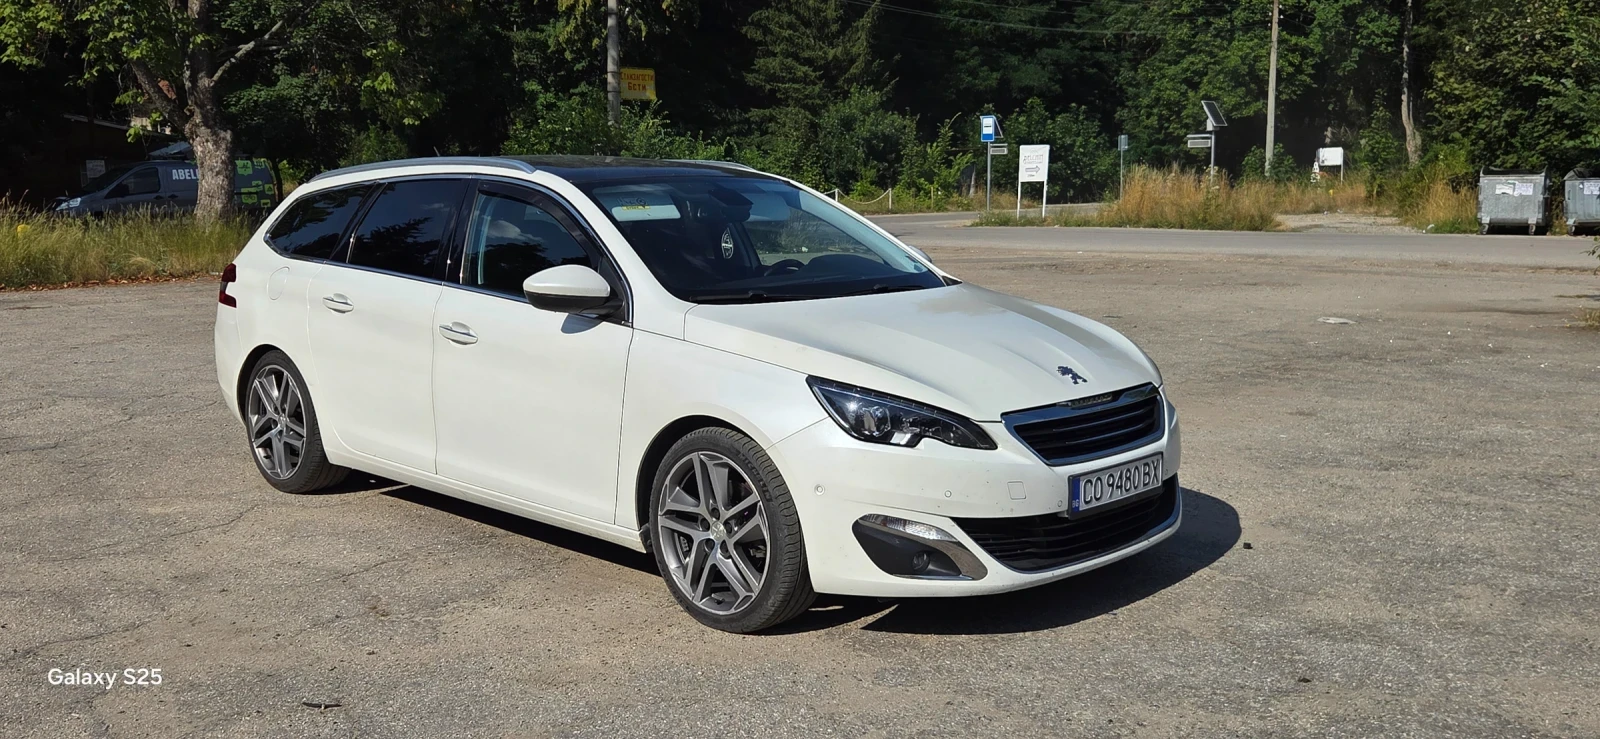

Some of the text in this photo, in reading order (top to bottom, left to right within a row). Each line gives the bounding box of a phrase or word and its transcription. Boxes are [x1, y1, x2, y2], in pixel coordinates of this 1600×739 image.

[1082, 459, 1160, 505] CO 9480 BX
